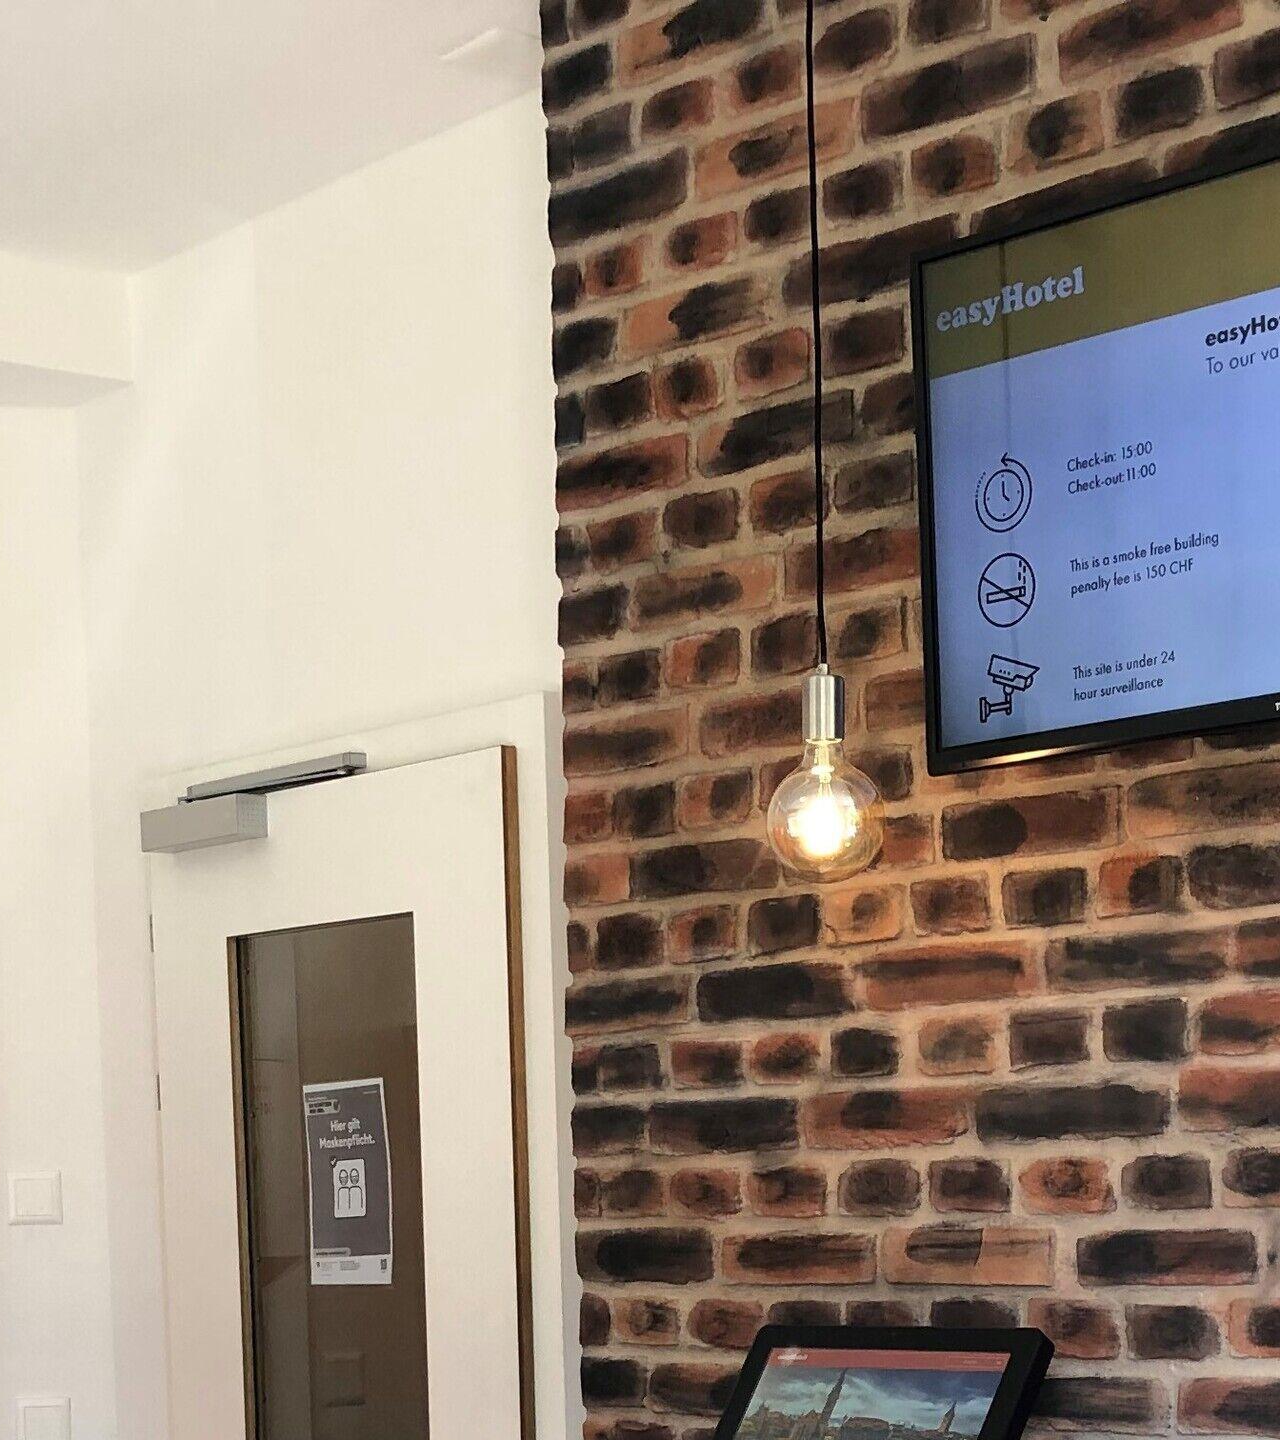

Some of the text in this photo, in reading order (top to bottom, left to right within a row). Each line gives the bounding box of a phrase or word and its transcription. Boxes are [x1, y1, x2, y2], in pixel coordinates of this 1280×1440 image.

[936, 265, 1085, 332] easyHotel
[1206, 356, 1224, 374] To
[1229, 352, 1256, 369] our
[1066, 440, 1153, 472] Check-in: 15:00
[1070, 532, 1219, 573] This is a smoke free building
[1071, 557, 1194, 598] penalty fee is 150 CHF
[1073, 650, 1176, 680] This site is under 24
[1073, 677, 1164, 701] hour surveillance
